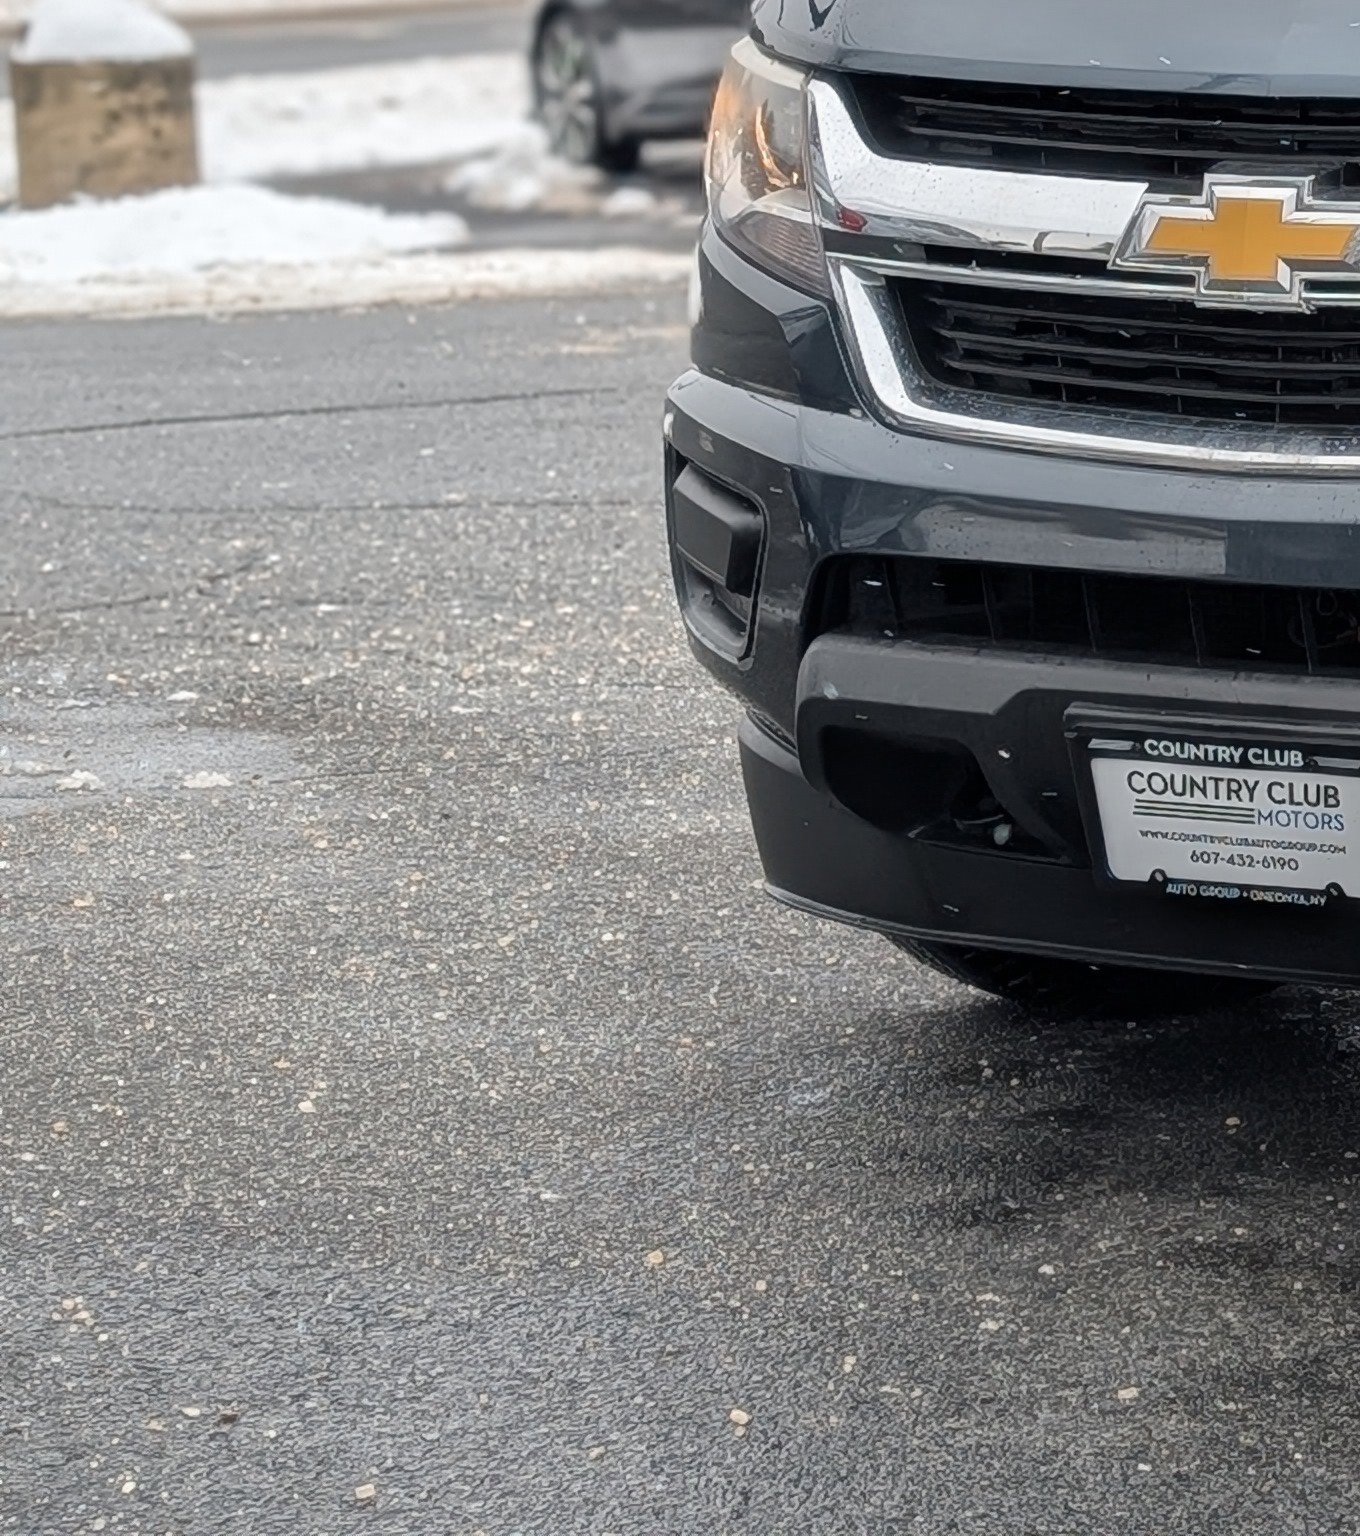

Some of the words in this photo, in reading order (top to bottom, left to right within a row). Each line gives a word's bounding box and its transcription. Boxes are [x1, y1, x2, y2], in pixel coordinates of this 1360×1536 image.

[1143, 739, 1244, 765] COUNTRY
[1247, 746, 1305, 767] CLUB
[1126, 769, 1260, 804] COUNTRY
[1266, 780, 1341, 809] CLUB
[1256, 808, 1346, 832] MOTORS
[1189, 849, 1299, 872] 607-432-6190
[1165, 882, 1198, 897] AUTO
[1199, 884, 1241, 899] GROUP
